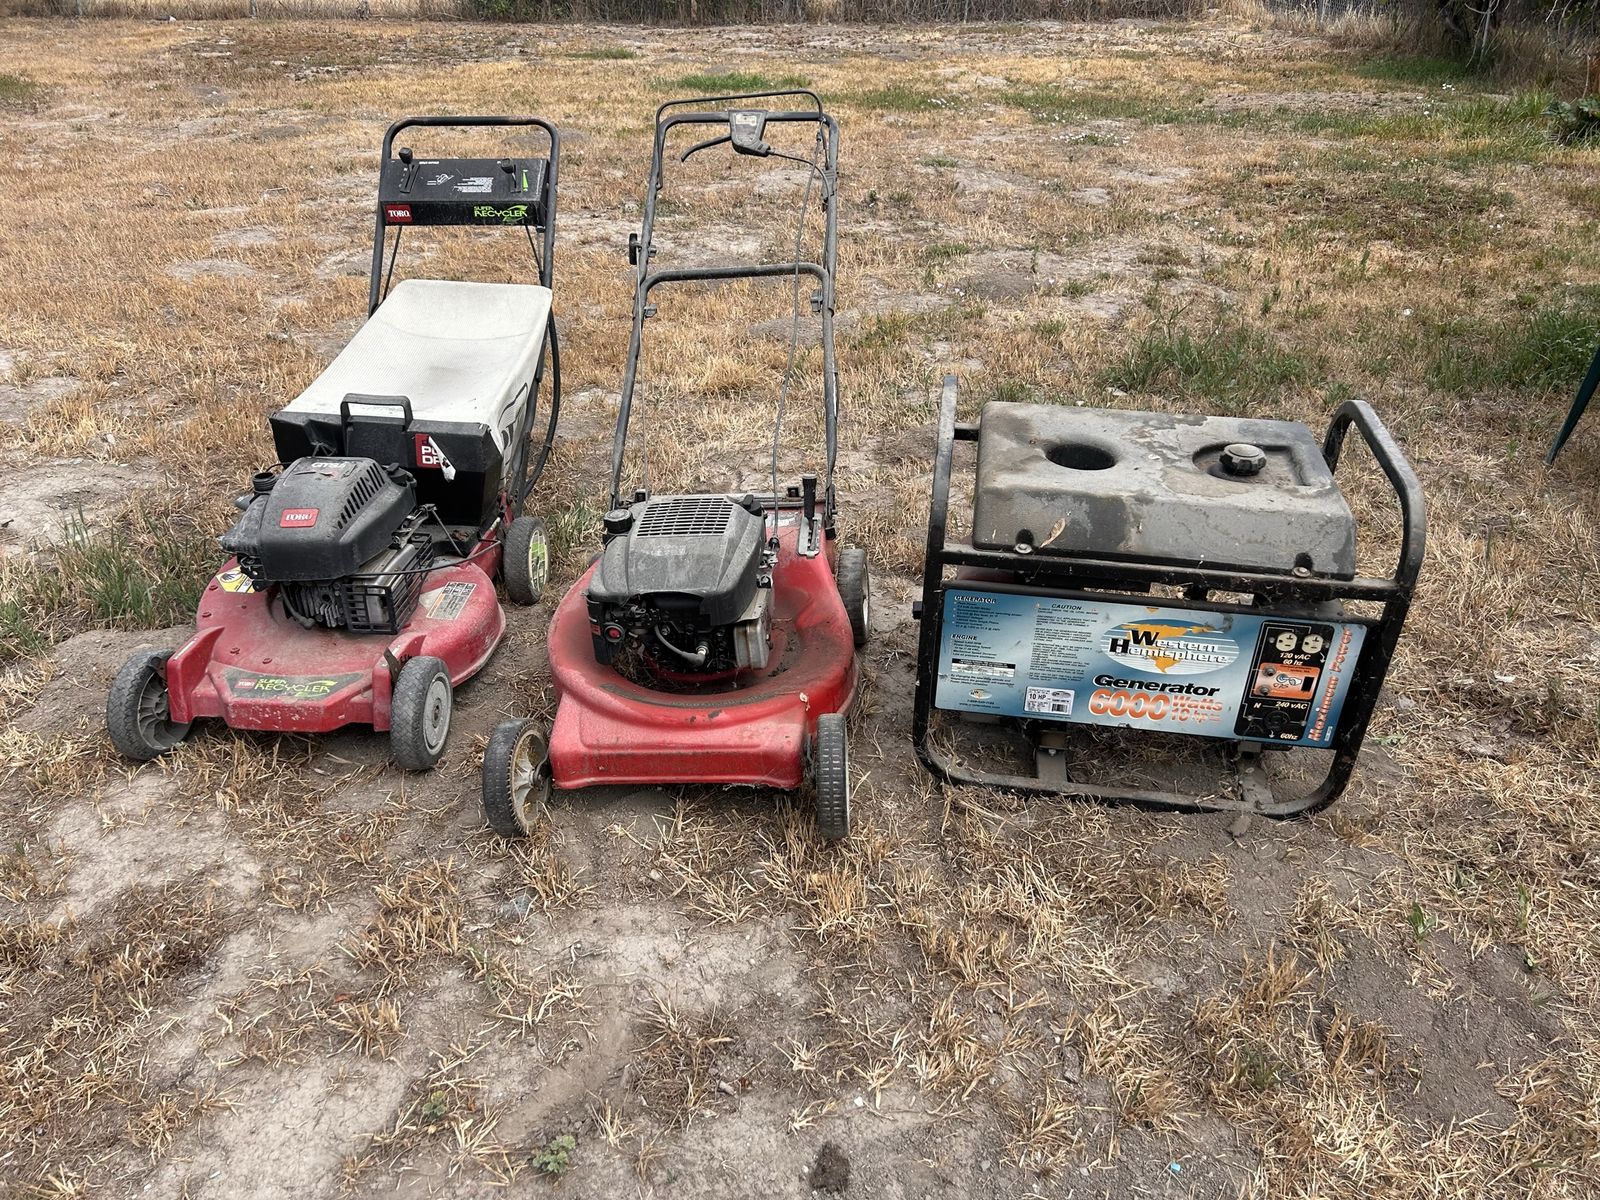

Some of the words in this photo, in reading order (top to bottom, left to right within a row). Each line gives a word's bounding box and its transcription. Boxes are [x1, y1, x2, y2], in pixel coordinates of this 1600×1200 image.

[954, 594, 996, 604] GENERATOR
[951, 633, 977, 641] ENGINE
[1129, 629, 1217, 653] Western
[1109, 637, 1229, 664] Hemisphere
[254, 683, 331, 693] RECYCLER
[1093, 674, 1220, 697] Generator
[1308, 675, 1340, 742] Maximum
[1329, 627, 1353, 673] Power
[1088, 688, 1171, 721] 6000
[1172, 695, 1223, 712] Watts
[1275, 701, 1290, 709] 240
[1171, 707, 1191, 722] 10
